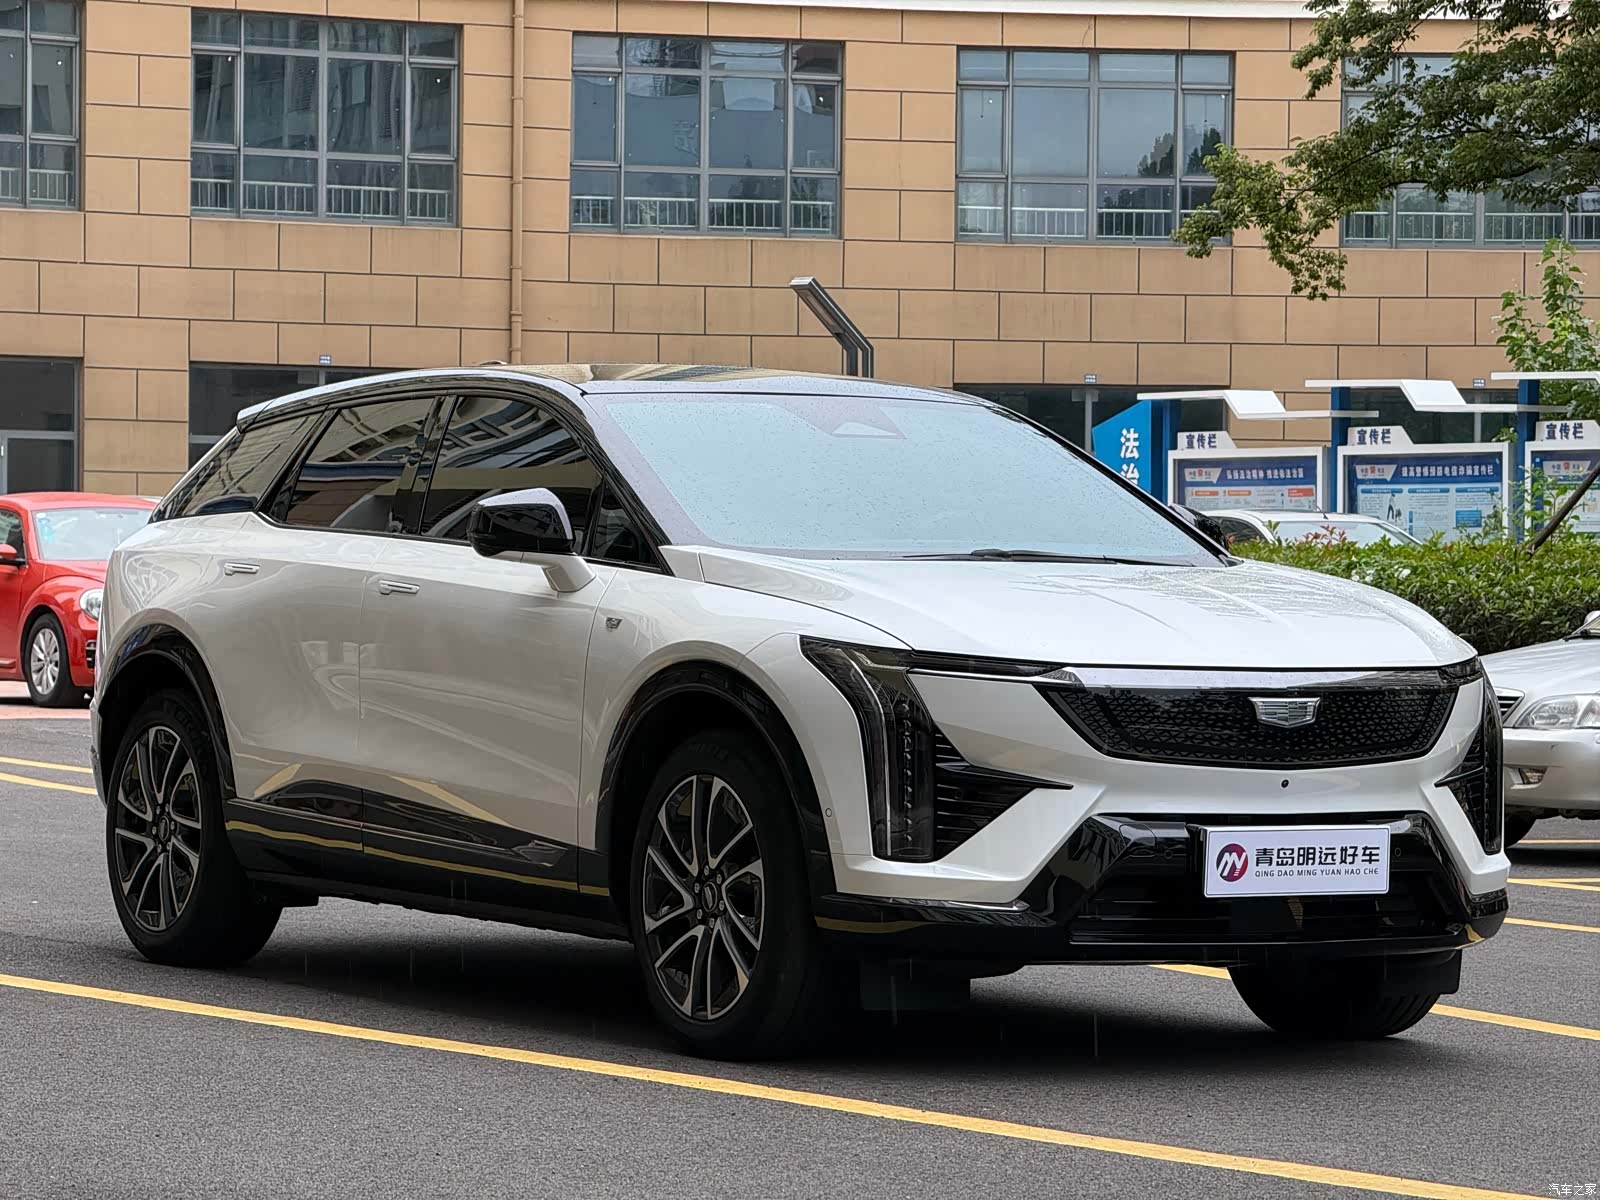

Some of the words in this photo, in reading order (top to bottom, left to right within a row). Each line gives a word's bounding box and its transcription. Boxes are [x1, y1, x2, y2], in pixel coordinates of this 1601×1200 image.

[1356, 428, 1392, 445] 宣传栏
[1545, 422, 1584, 440] 宣传栏
[1185, 433, 1218, 449] 宣传栏
[1255, 846, 1381, 867] 青岛明远好车
[1277, 869, 1294, 877] DAO
[1363, 867, 1379, 875] CHE
